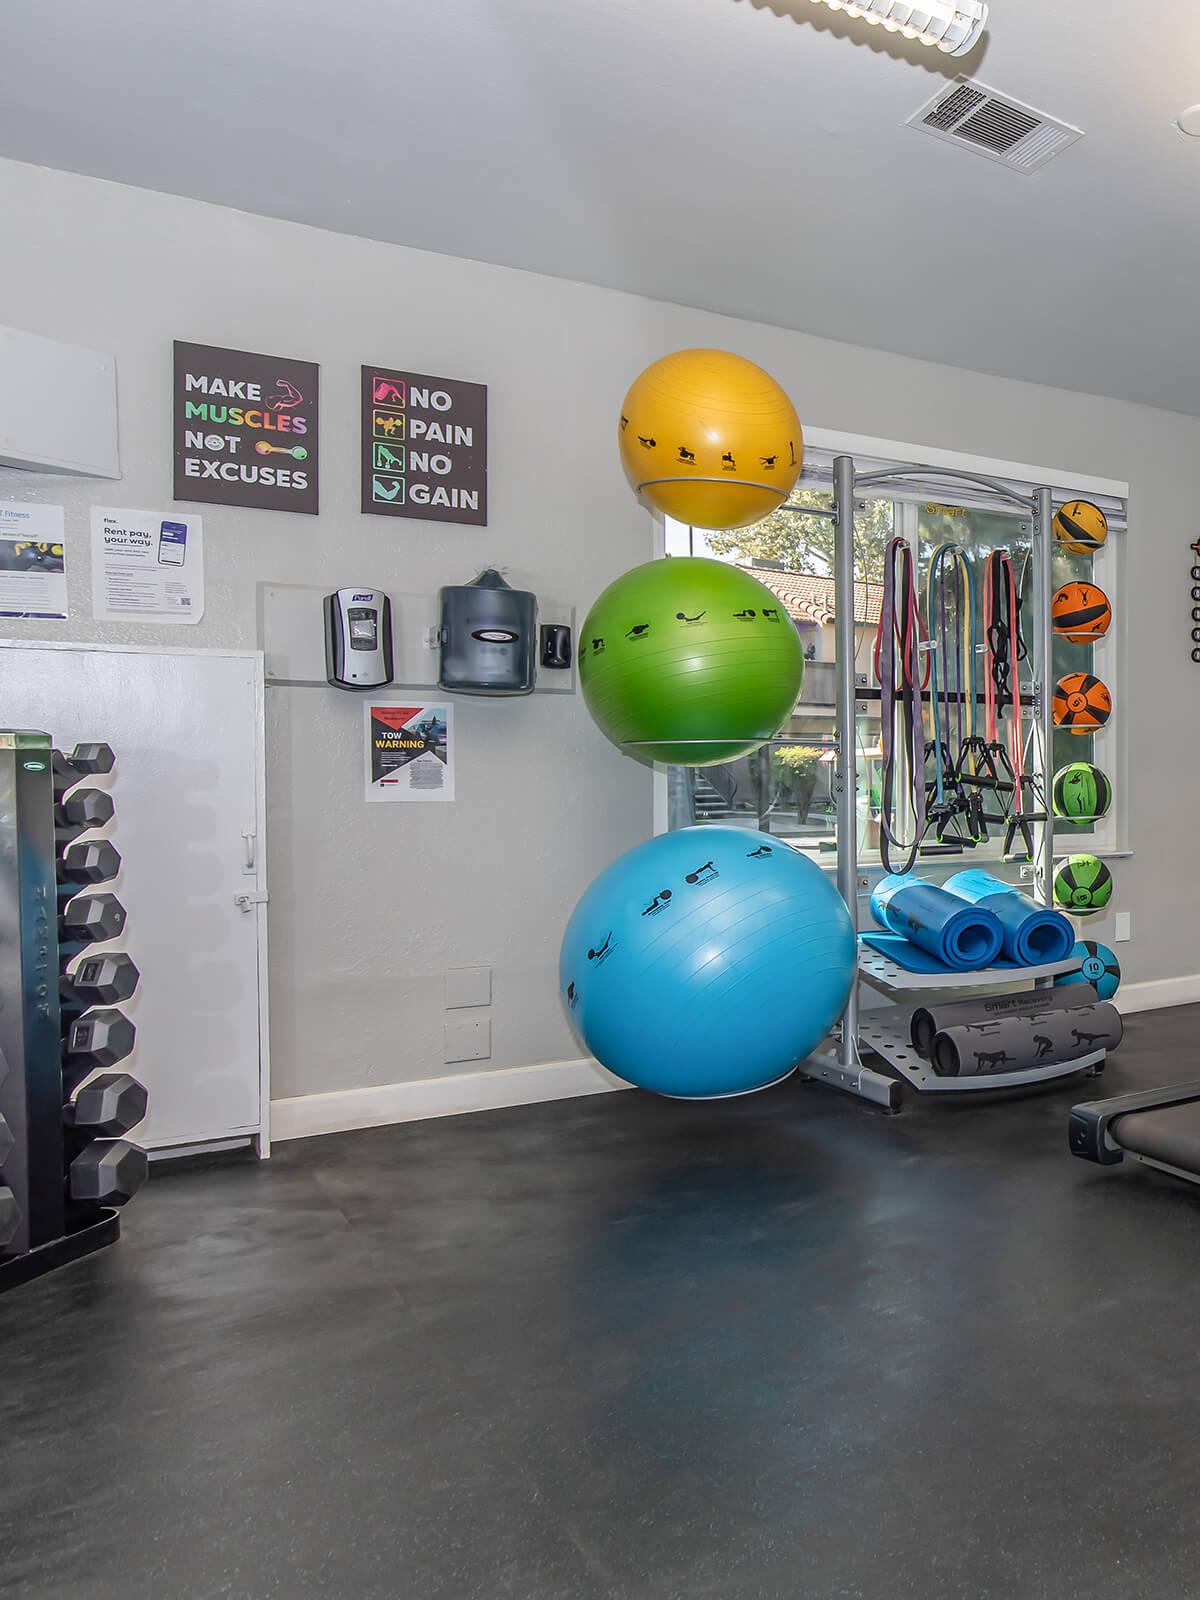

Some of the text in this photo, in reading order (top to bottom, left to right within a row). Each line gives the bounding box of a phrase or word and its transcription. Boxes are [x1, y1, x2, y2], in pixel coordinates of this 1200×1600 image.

[185, 373, 262, 401] MAKE
[409, 386, 452, 412] NO
[185, 401, 308, 435] MUSCLES
[184, 430, 241, 454] NOT
[409, 418, 473, 447] PAIN
[184, 457, 308, 490] EXCUSES
[409, 451, 452, 475] NO
[408, 483, 479, 511] GAIN
[104, 527, 128, 536] Rent
[129, 531, 152, 539] pay,
[104, 536, 153, 547] your way.
[375, 740, 425, 749] WARNING
[1088, 962, 1099, 972] 10
